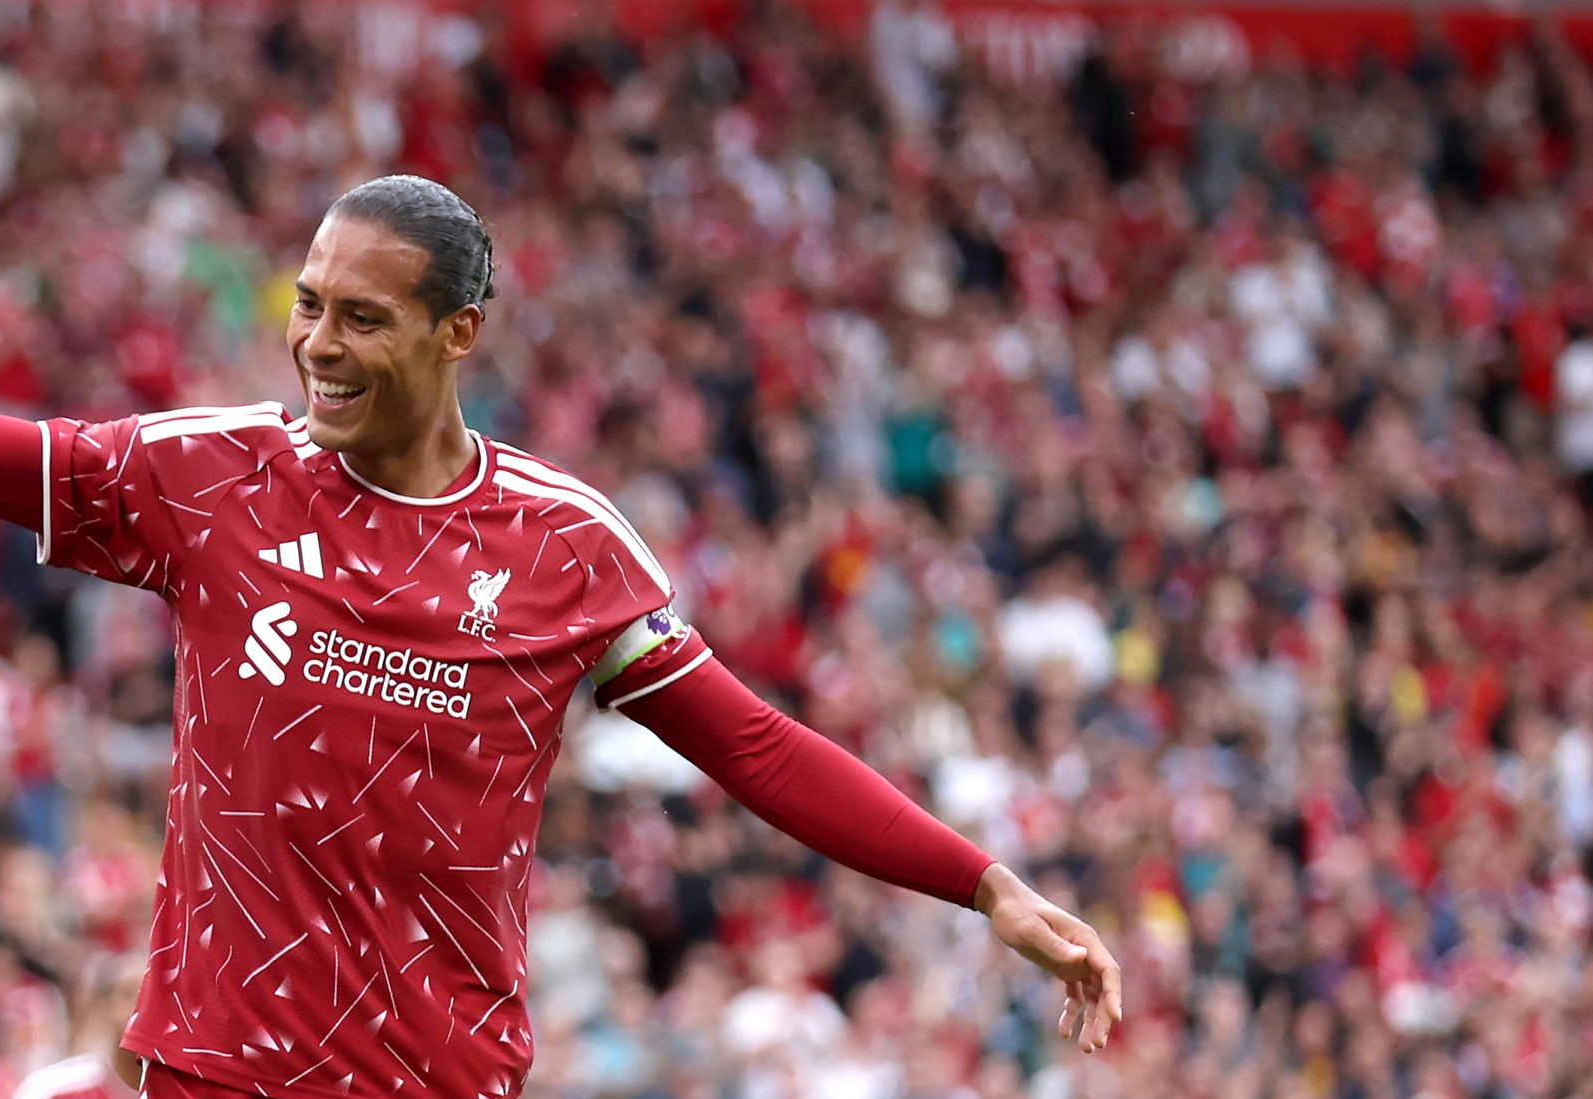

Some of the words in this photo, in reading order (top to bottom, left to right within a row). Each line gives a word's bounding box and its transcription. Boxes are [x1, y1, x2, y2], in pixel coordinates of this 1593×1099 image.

[457, 614, 497, 643] L.F.C.
[303, 657, 472, 720] chartered
[309, 629, 469, 690] standard
